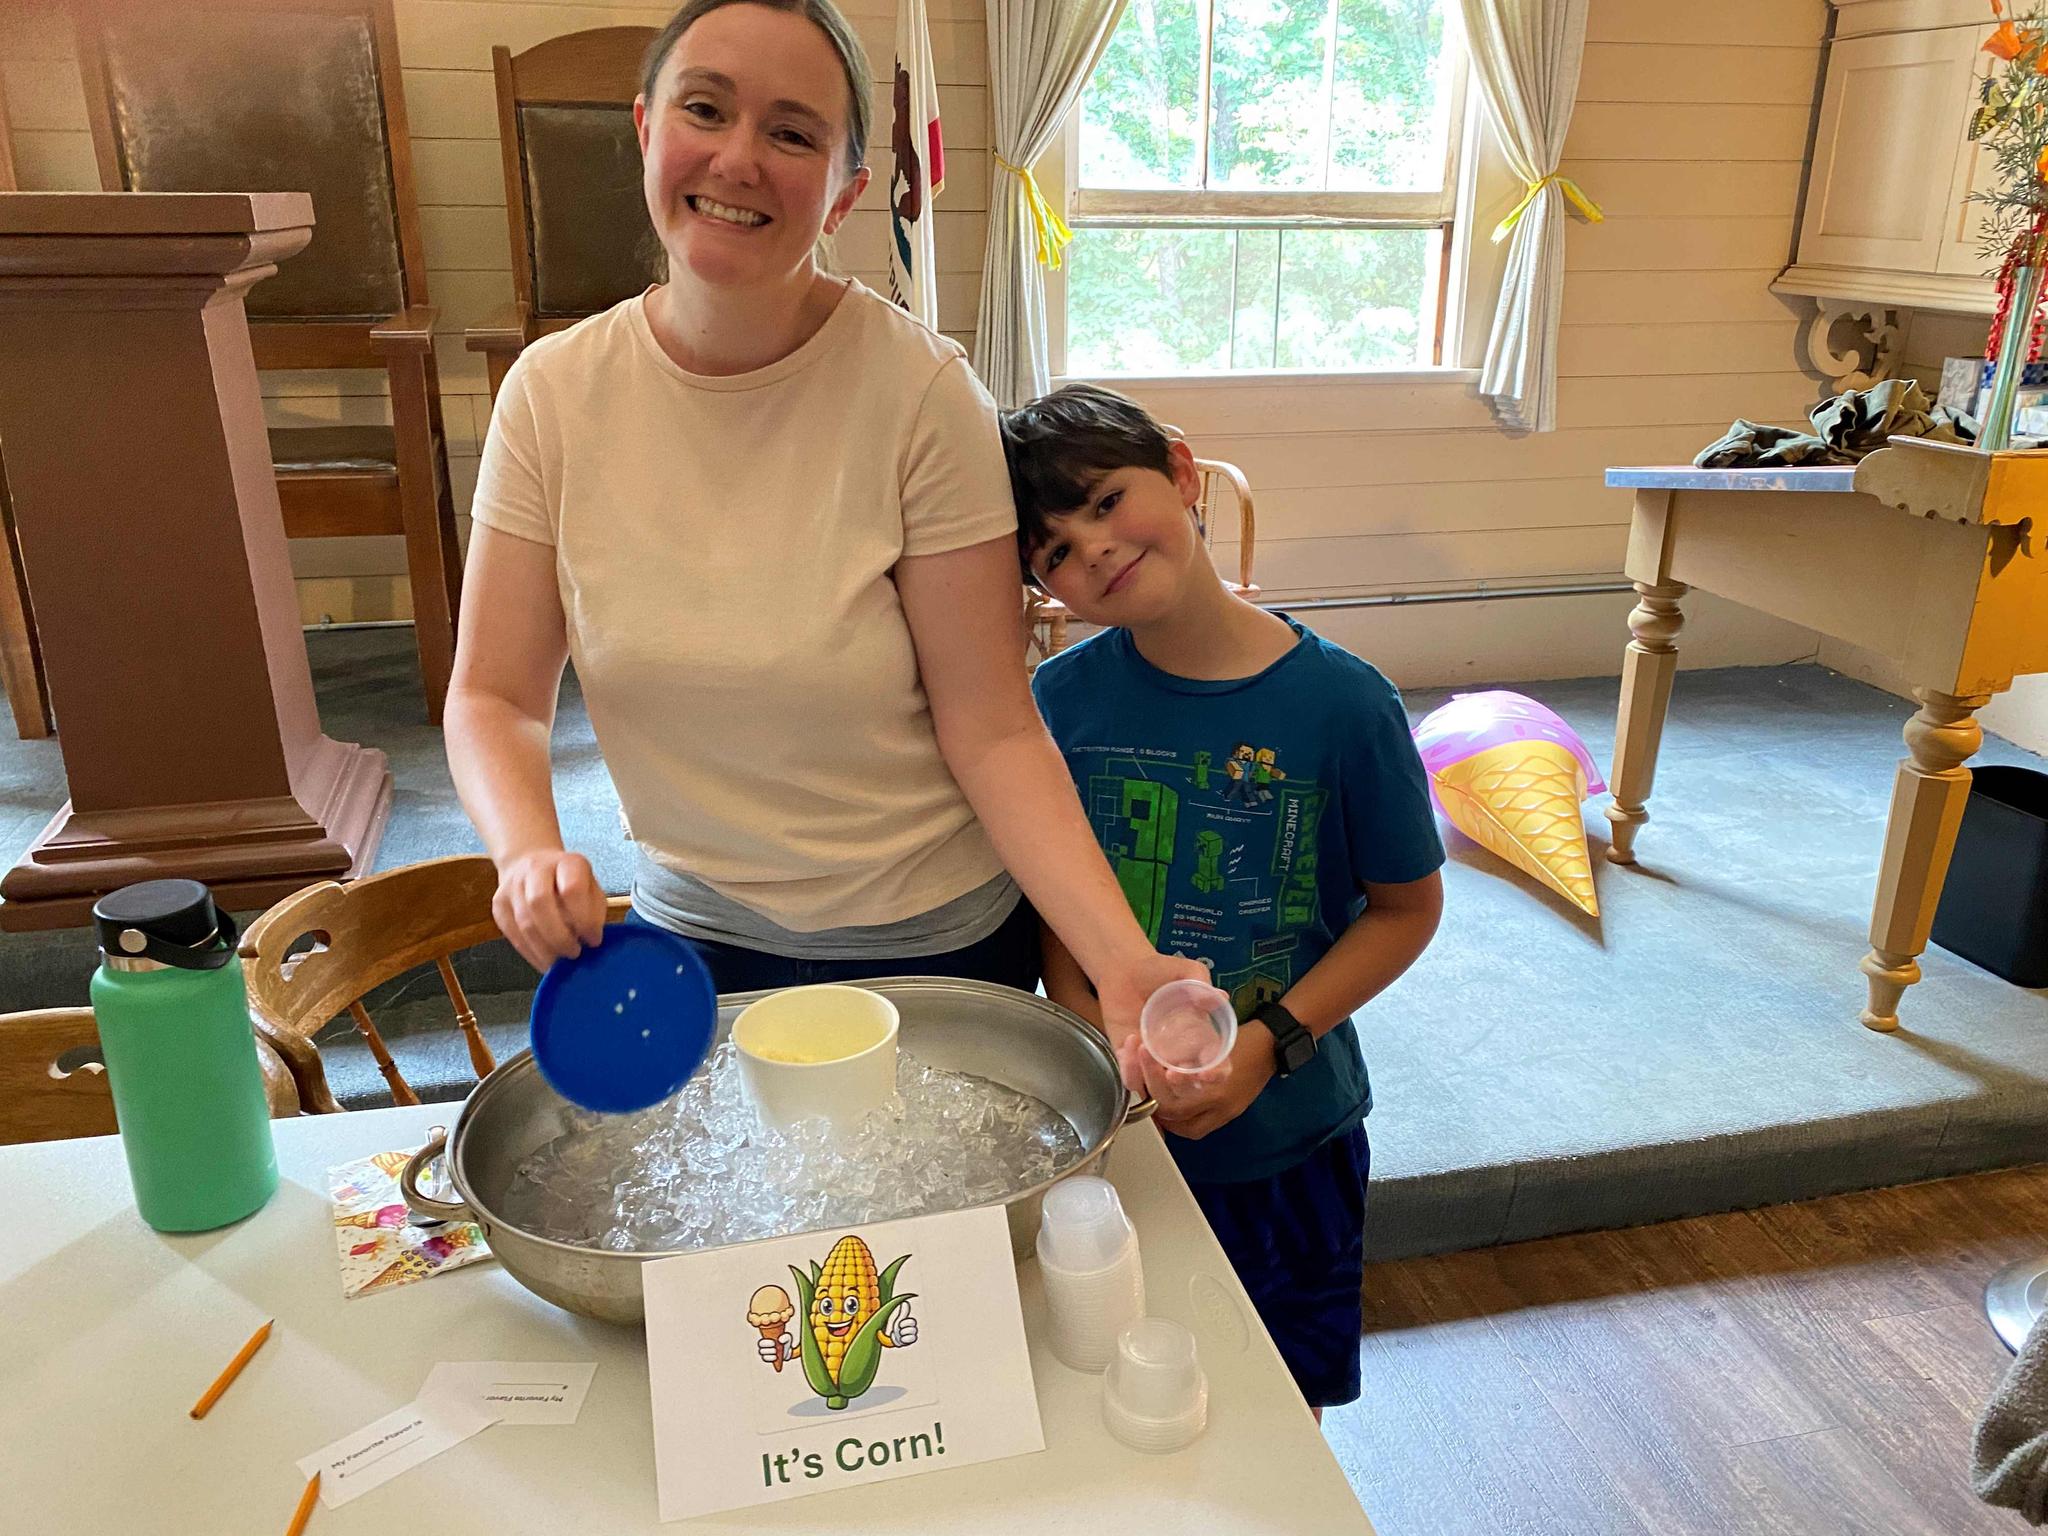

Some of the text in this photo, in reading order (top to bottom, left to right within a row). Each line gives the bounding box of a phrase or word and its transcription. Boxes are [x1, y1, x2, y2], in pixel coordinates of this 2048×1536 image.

[1279, 798, 1299, 872] MINECRAFT
[1174, 903, 1223, 916] OVERWORLD
[1186, 915, 1217, 926] HEALTH
[1170, 940, 1198, 948] DROPS
[1201, 933, 1236, 942] ATTACK
[331, 1459, 346, 1469] My
[346, 1440, 384, 1461] Favorite
[762, 1422, 946, 1487] It’s Corn!
